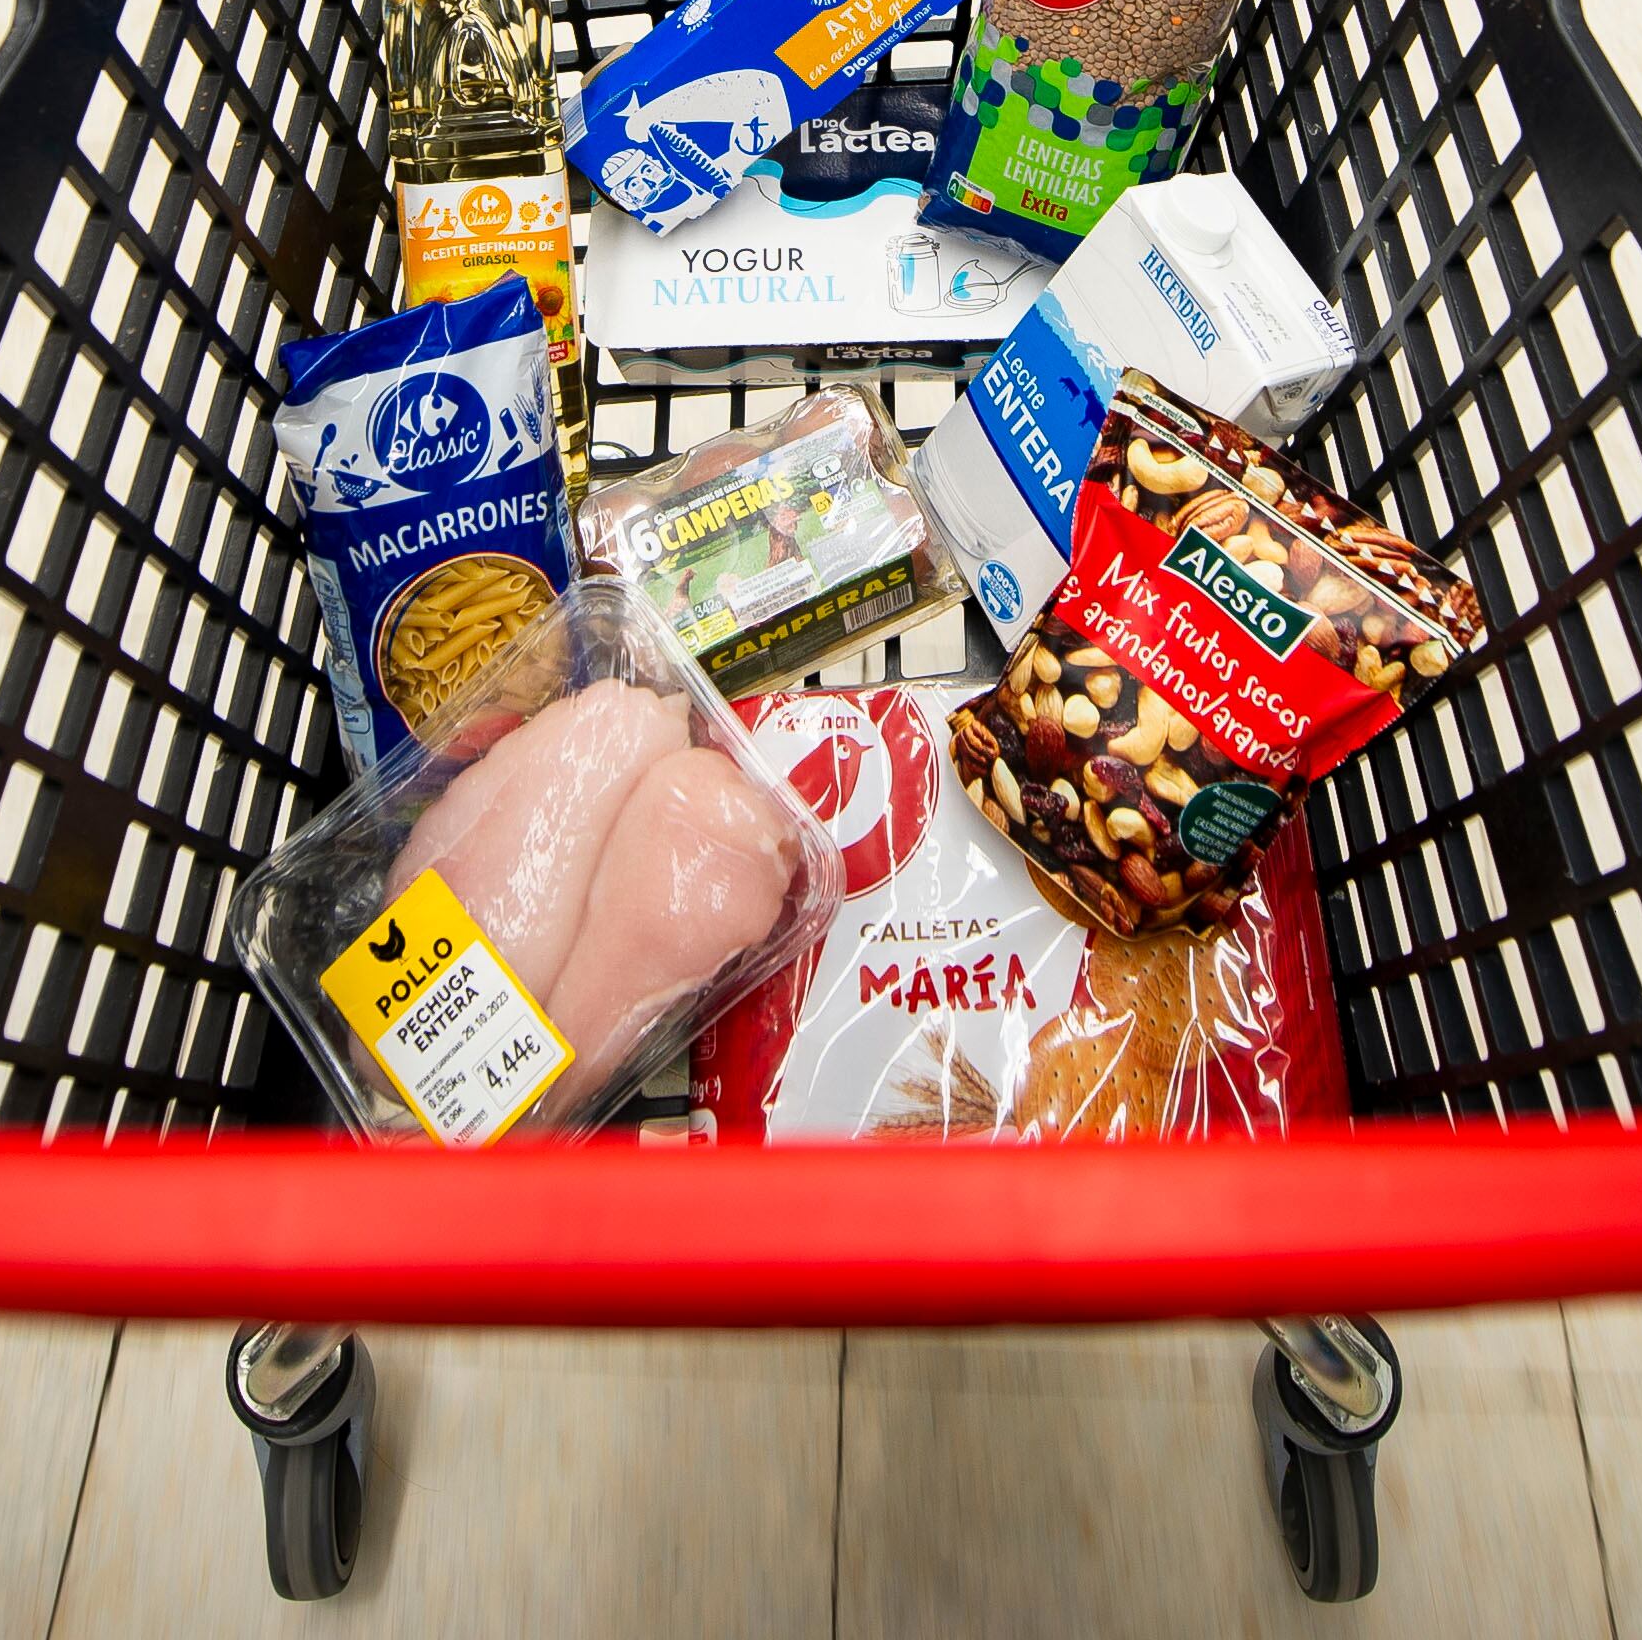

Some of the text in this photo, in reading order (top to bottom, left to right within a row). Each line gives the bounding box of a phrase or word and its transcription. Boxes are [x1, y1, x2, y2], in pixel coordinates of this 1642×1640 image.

[914, 3, 933, 20] mar
[809, 63, 828, 81] en
[830, 27, 867, 65] aceite
[869, 10, 885, 31] de
[800, 117, 935, 154] Láctea
[1016, 134, 1105, 181] LENTEJAS
[1003, 156, 1103, 208] LENTILHAS
[1020, 188, 1069, 222] Extra
[423, 240, 555, 262] ACEITE REFINADO DE
[462, 253, 519, 268] GIRASOL
[681, 248, 805, 274] YOGUR
[652, 274, 845, 307] NATURAL
[1143, 249, 1216, 351] HACENDADO
[1313, 300, 1350, 342] LITRO
[1003, 342, 1046, 411] Leche
[982, 360, 1077, 515] ENTERA
[348, 491, 550, 573] MACARRONES
[630, 518, 663, 562] 6
[658, 471, 794, 551] CAMPERAS
[710, 567, 908, 671] CAMPERAS
[1178, 546, 1289, 641] Alesto
[1098, 552, 1159, 617] Mix
[1167, 599, 1240, 683] frutos
[1238, 675, 1312, 739] secos
[860, 918, 1002, 943] GALLETAS
[375, 937, 453, 1019] POLLO
[396, 965, 475, 1045] PECHUGA
[859, 953, 1037, 1015] MARÍA
[413, 986, 480, 1054] ENTERA
[486, 1035, 541, 1090] 4,44€
